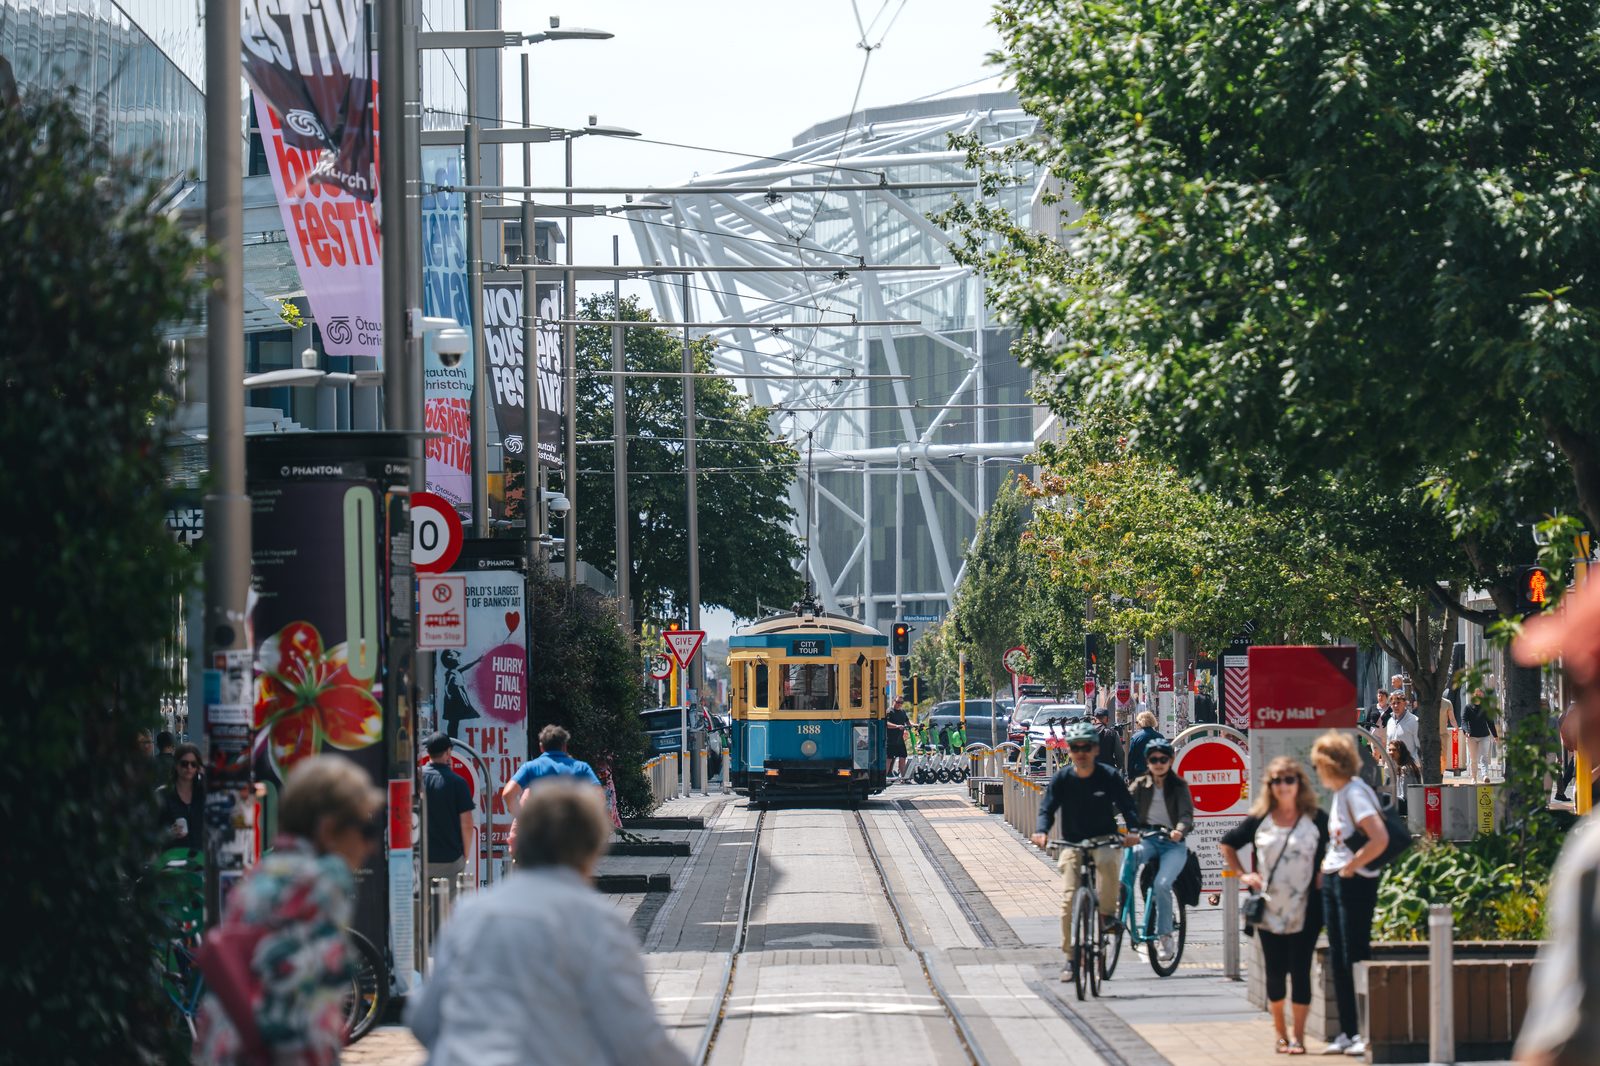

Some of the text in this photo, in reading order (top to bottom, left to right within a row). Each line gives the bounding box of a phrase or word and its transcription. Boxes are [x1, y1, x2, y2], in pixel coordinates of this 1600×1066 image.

[426, 367, 467, 378] tautahi
[292, 466, 343, 475] PHANTOM
[465, 586, 519, 597] ORLD'S LARGEST
[472, 597, 482, 608] OF
[483, 597, 511, 607] BANKSY
[511, 597, 521, 607] ART
[425, 632, 460, 641] Tram Stop
[675, 637, 692, 645] GIVE
[492, 656, 524, 675] HURRY,
[496, 674, 521, 694] FINAL
[494, 693, 521, 712] DAYS!
[1257, 707, 1284, 722] City
[1286, 707, 1314, 719] Mall
[797, 724, 820, 735] 1888
[465, 727, 509, 756] THE
[1193, 773, 1231, 782] NO ENTRY
